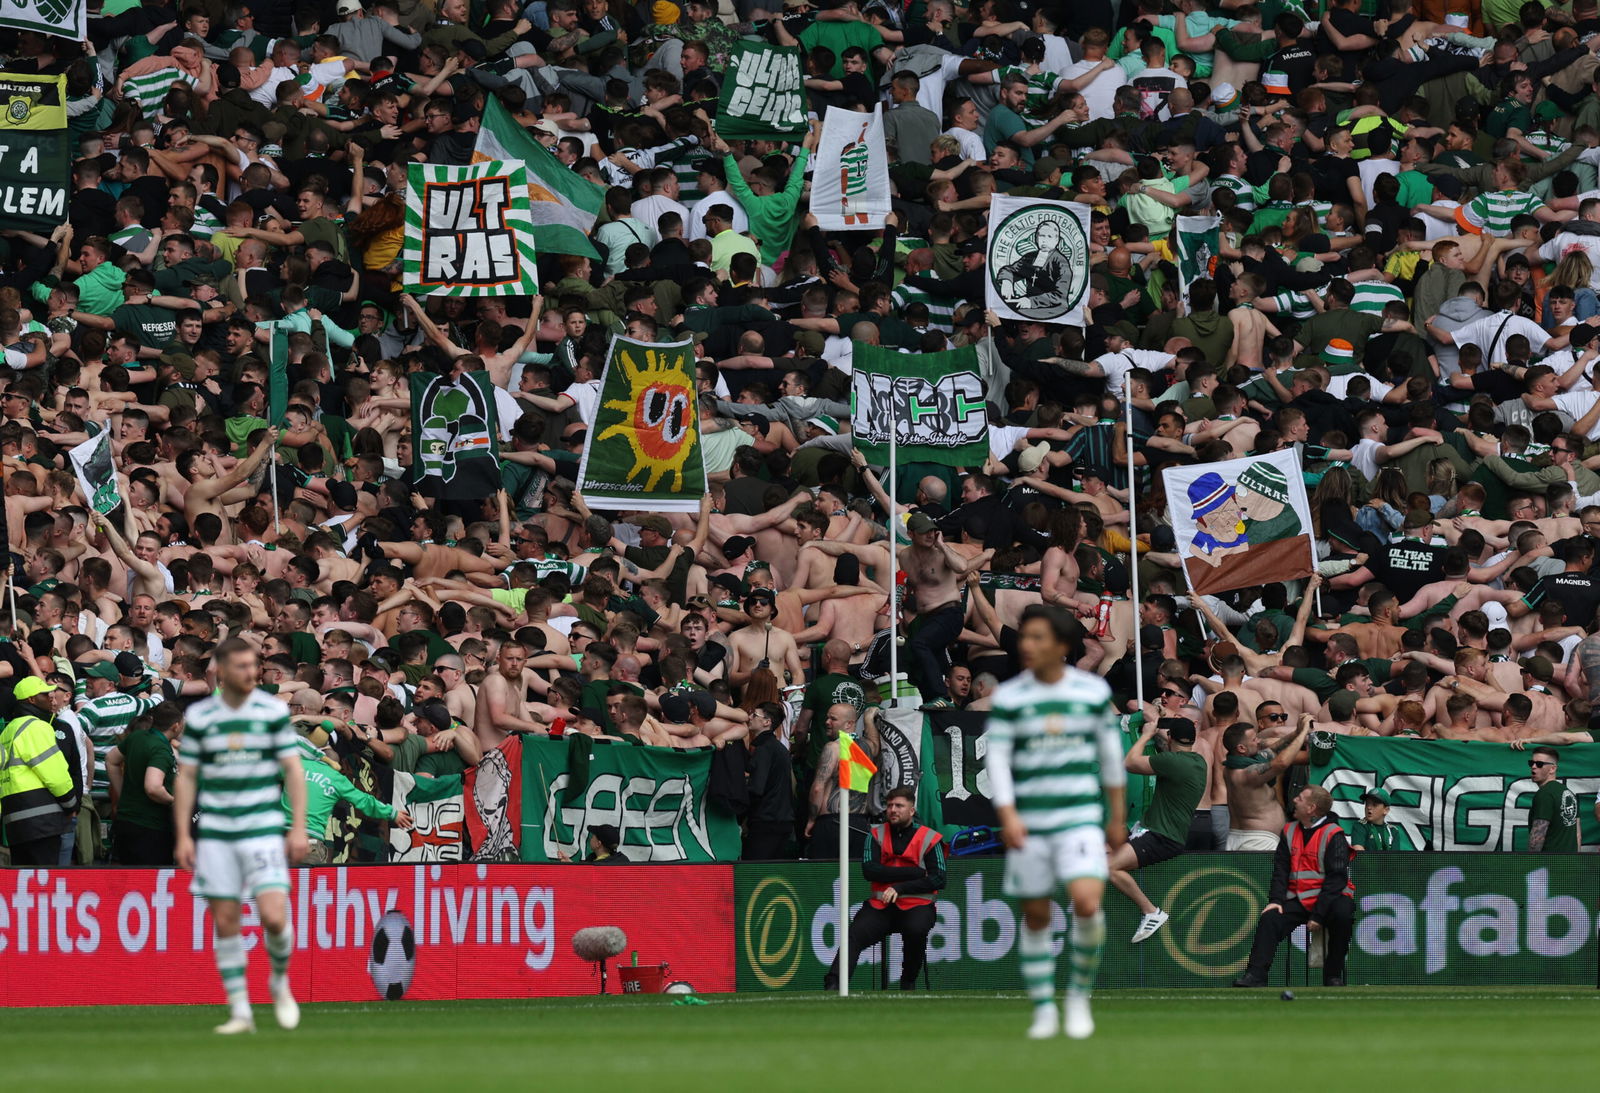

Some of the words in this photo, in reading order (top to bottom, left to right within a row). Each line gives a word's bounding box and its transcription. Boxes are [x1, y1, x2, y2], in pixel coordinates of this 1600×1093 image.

[736, 49, 800, 91] ULTRAS
[0, 83, 41, 93] ULTRAS
[726, 86, 804, 127] CELTIC
[20, 146, 39, 174] A
[0, 186, 66, 216] LEM
[429, 182, 505, 231] ULT
[996, 238, 1010, 260] THE
[1004, 214, 1036, 239] CELTIC
[1037, 213, 1079, 240] FOOTBALL
[1075, 239, 1085, 267] CLUB
[427, 231, 515, 280] RAS
[866, 429, 897, 445] Spiri
[896, 433, 909, 447] of
[909, 432, 926, 443] the
[927, 430, 969, 447] Jungle
[1240, 473, 1289, 504] ULTRAS
[1390, 557, 1430, 571] CELTIC
[1555, 577, 1592, 587] MAGNERS
[898, 744, 914, 770] WITH
[903, 771, 915, 786] US
[117, 869, 176, 952] of
[413, 863, 556, 970] living
